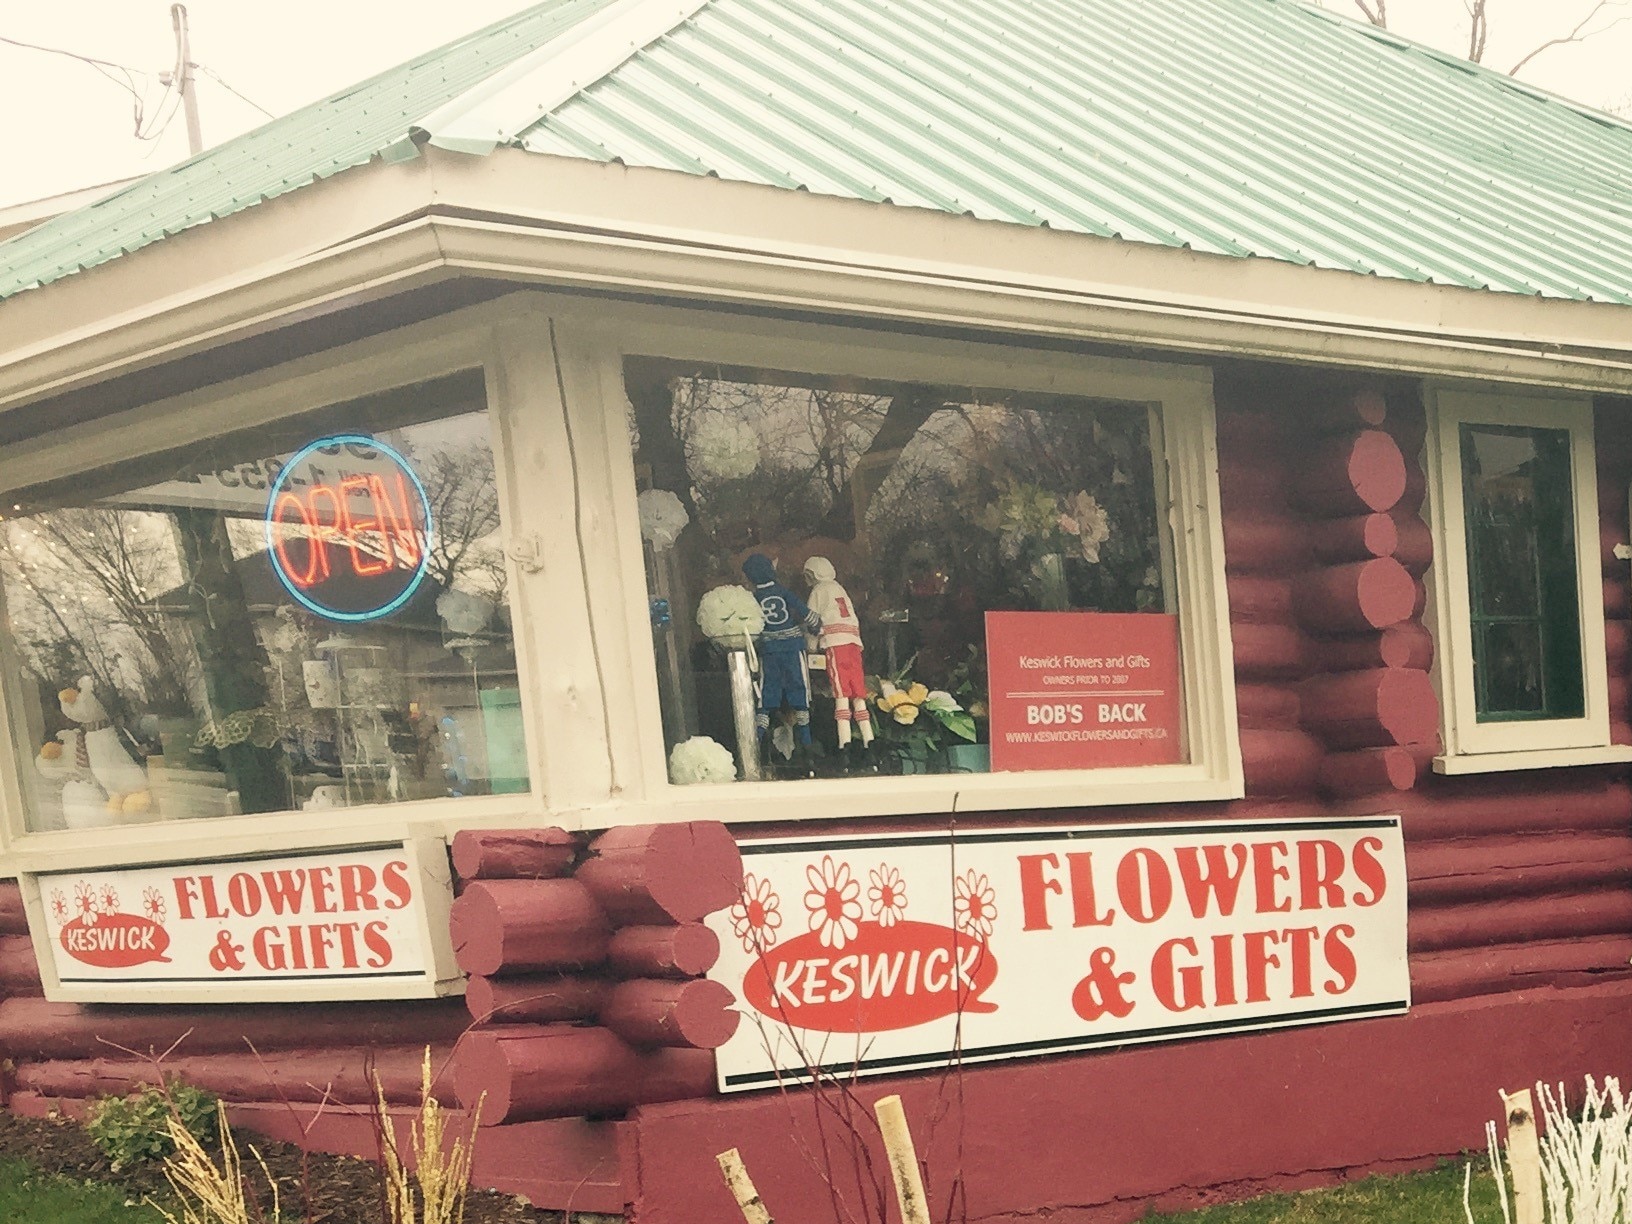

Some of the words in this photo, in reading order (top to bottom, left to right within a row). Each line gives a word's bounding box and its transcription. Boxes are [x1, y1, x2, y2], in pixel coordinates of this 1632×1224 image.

[273, 471, 421, 589] OPEN
[1019, 655, 1062, 669] Keswick
[1063, 654, 1103, 669] Flowers
[1105, 654, 1125, 668] and
[1126, 653, 1151, 668] Gifts
[1042, 674, 1075, 685] OWNERS
[1100, 674, 1111, 685] TO
[1005, 727, 1169, 744] WWW.KESWICKFLOWERSANDGIFTS.CA
[1026, 703, 1084, 726] BOB'S
[1098, 702, 1147, 724] BACK
[172, 860, 413, 920] FLOWERS
[1016, 836, 1388, 932] FLOWERS
[67, 924, 156, 952] KESWICK
[208, 929, 246, 972] &
[252, 920, 394, 971] GIFTS
[769, 944, 980, 1009] KESWICK
[1070, 946, 1137, 1023] &
[1150, 923, 1358, 1014] GIFTS
